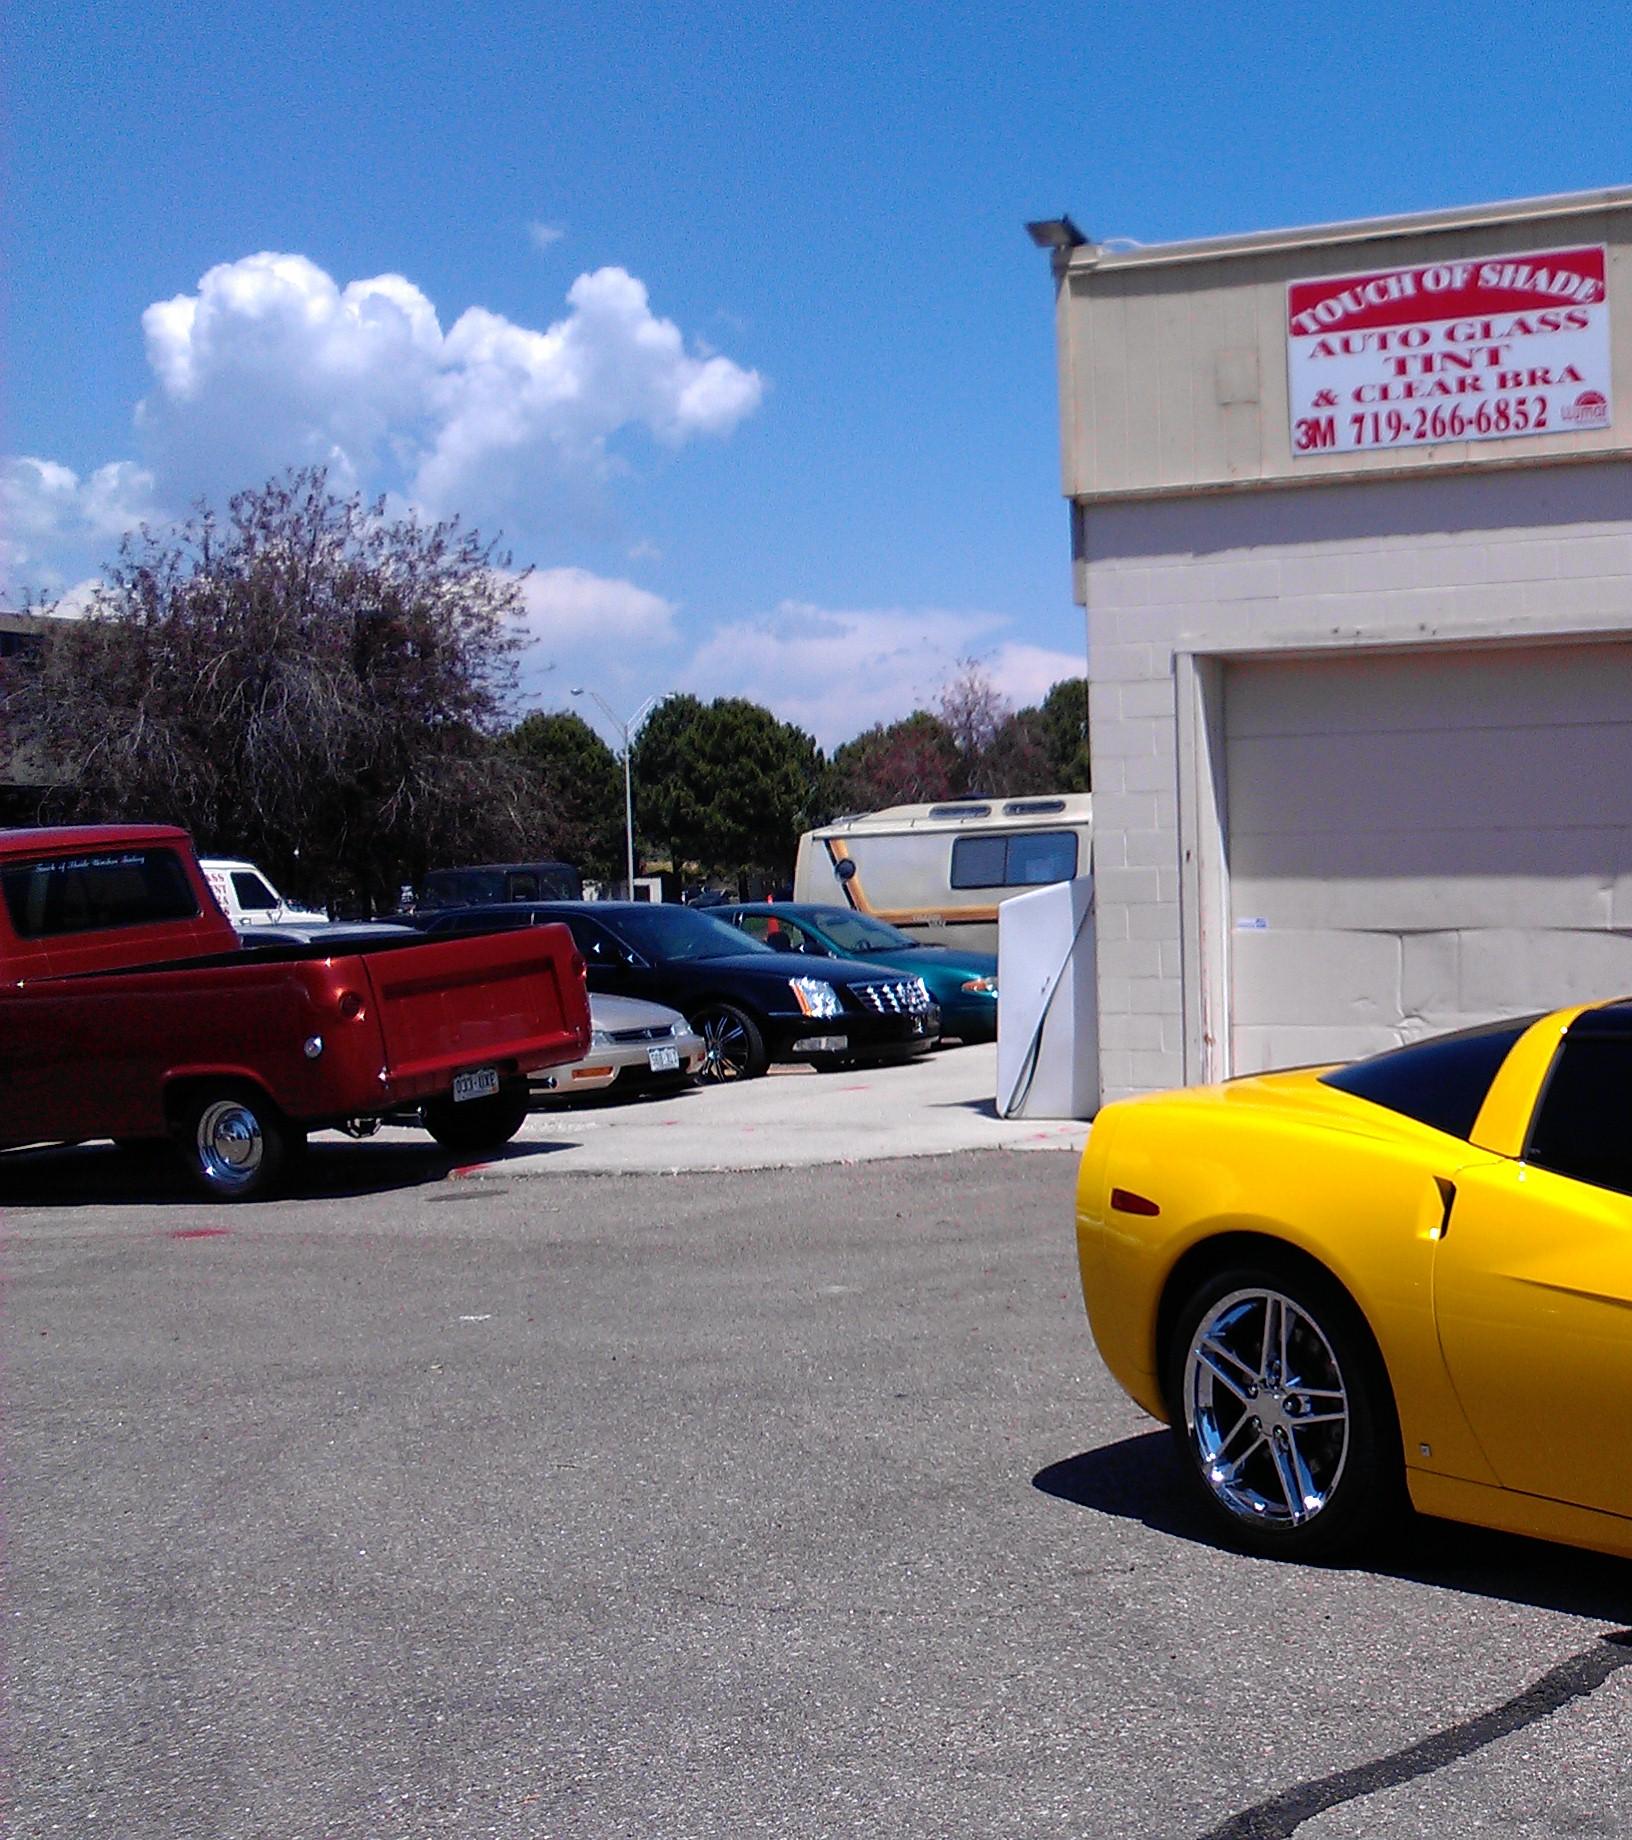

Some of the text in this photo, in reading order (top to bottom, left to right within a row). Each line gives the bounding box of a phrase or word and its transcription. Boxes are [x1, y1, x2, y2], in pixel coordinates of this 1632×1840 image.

[1291, 263, 1603, 333] TOUCH OF SHADE
[1308, 309, 1590, 359] AUTO GLASS
[1382, 343, 1512, 377] TINT
[1311, 364, 1585, 408] & CLEAR BRA
[1295, 395, 1548, 449] 3M 719-266-6852
